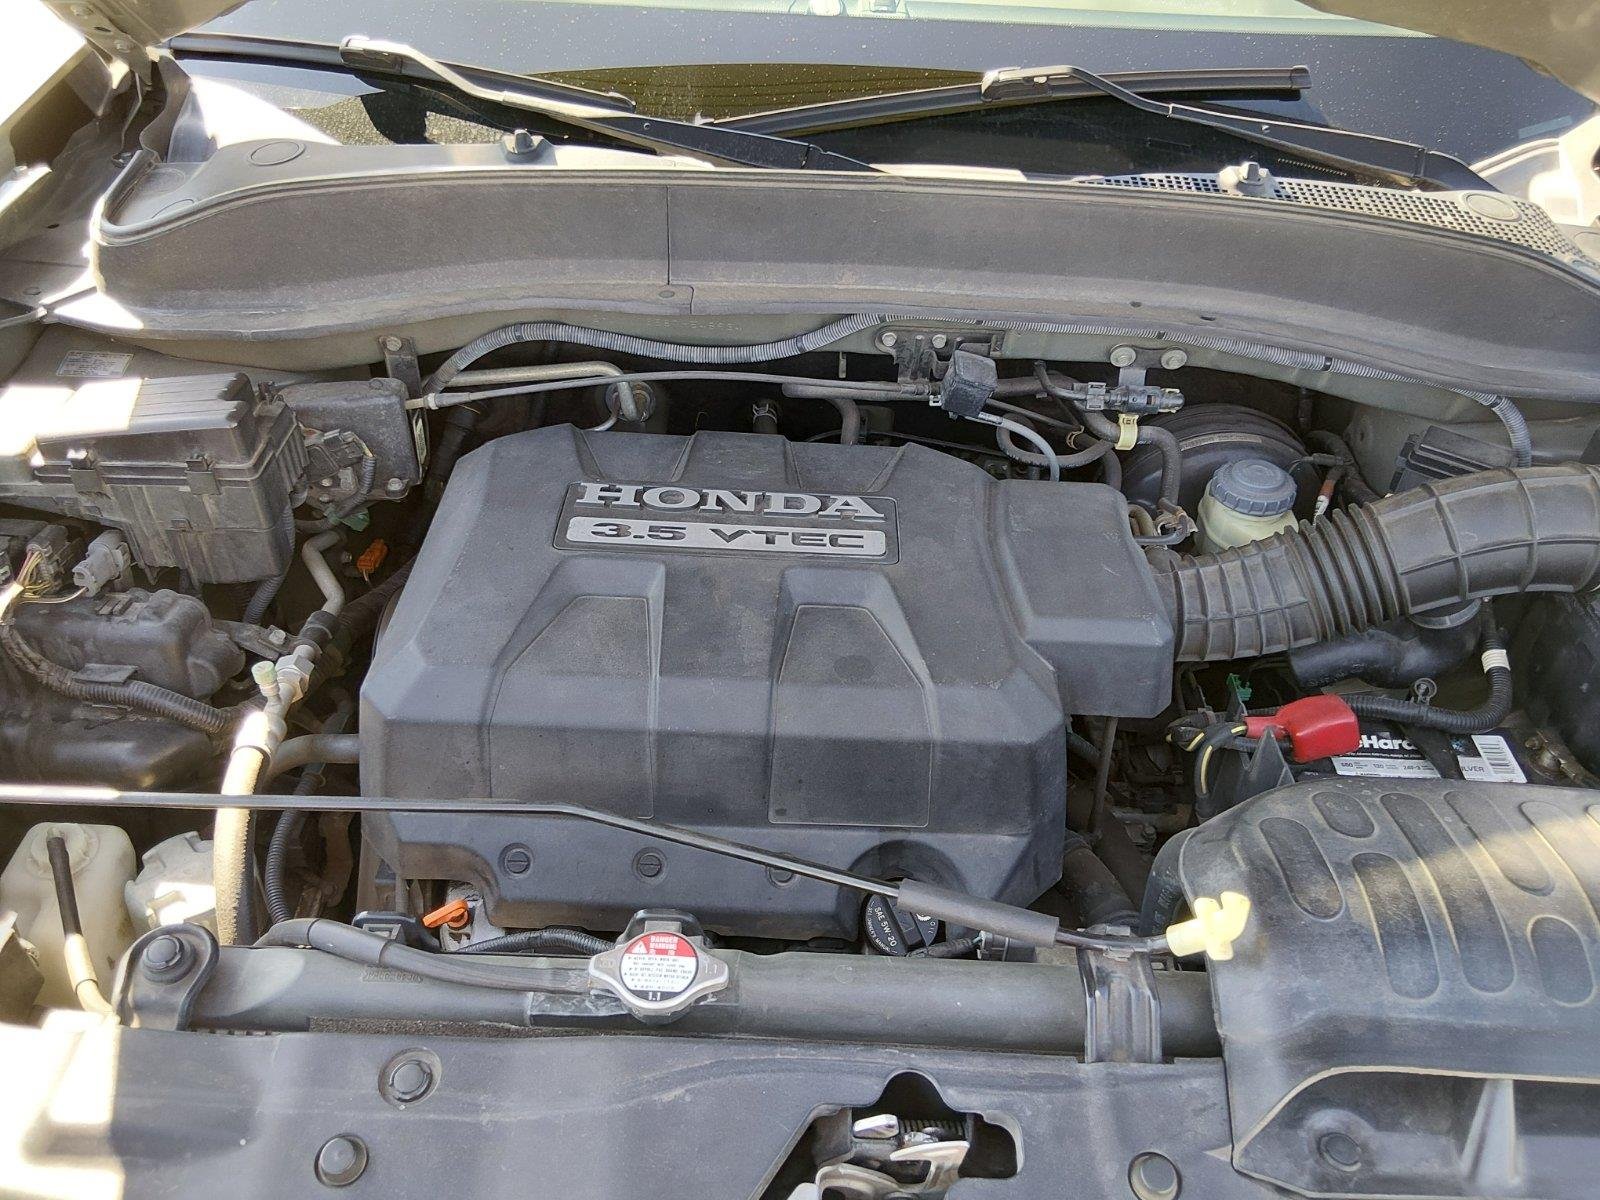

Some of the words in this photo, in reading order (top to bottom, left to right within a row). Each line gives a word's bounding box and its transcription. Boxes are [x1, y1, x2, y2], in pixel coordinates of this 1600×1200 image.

[574, 483, 887, 522] HONDA
[591, 522, 686, 541] 3.5
[708, 528, 864, 549] VTEC
[650, 935, 679, 944] DANGER
[874, 906, 886, 921] SAE
[880, 920, 898, 947] 5W-20
[648, 991, 661, 1001] 1.1
